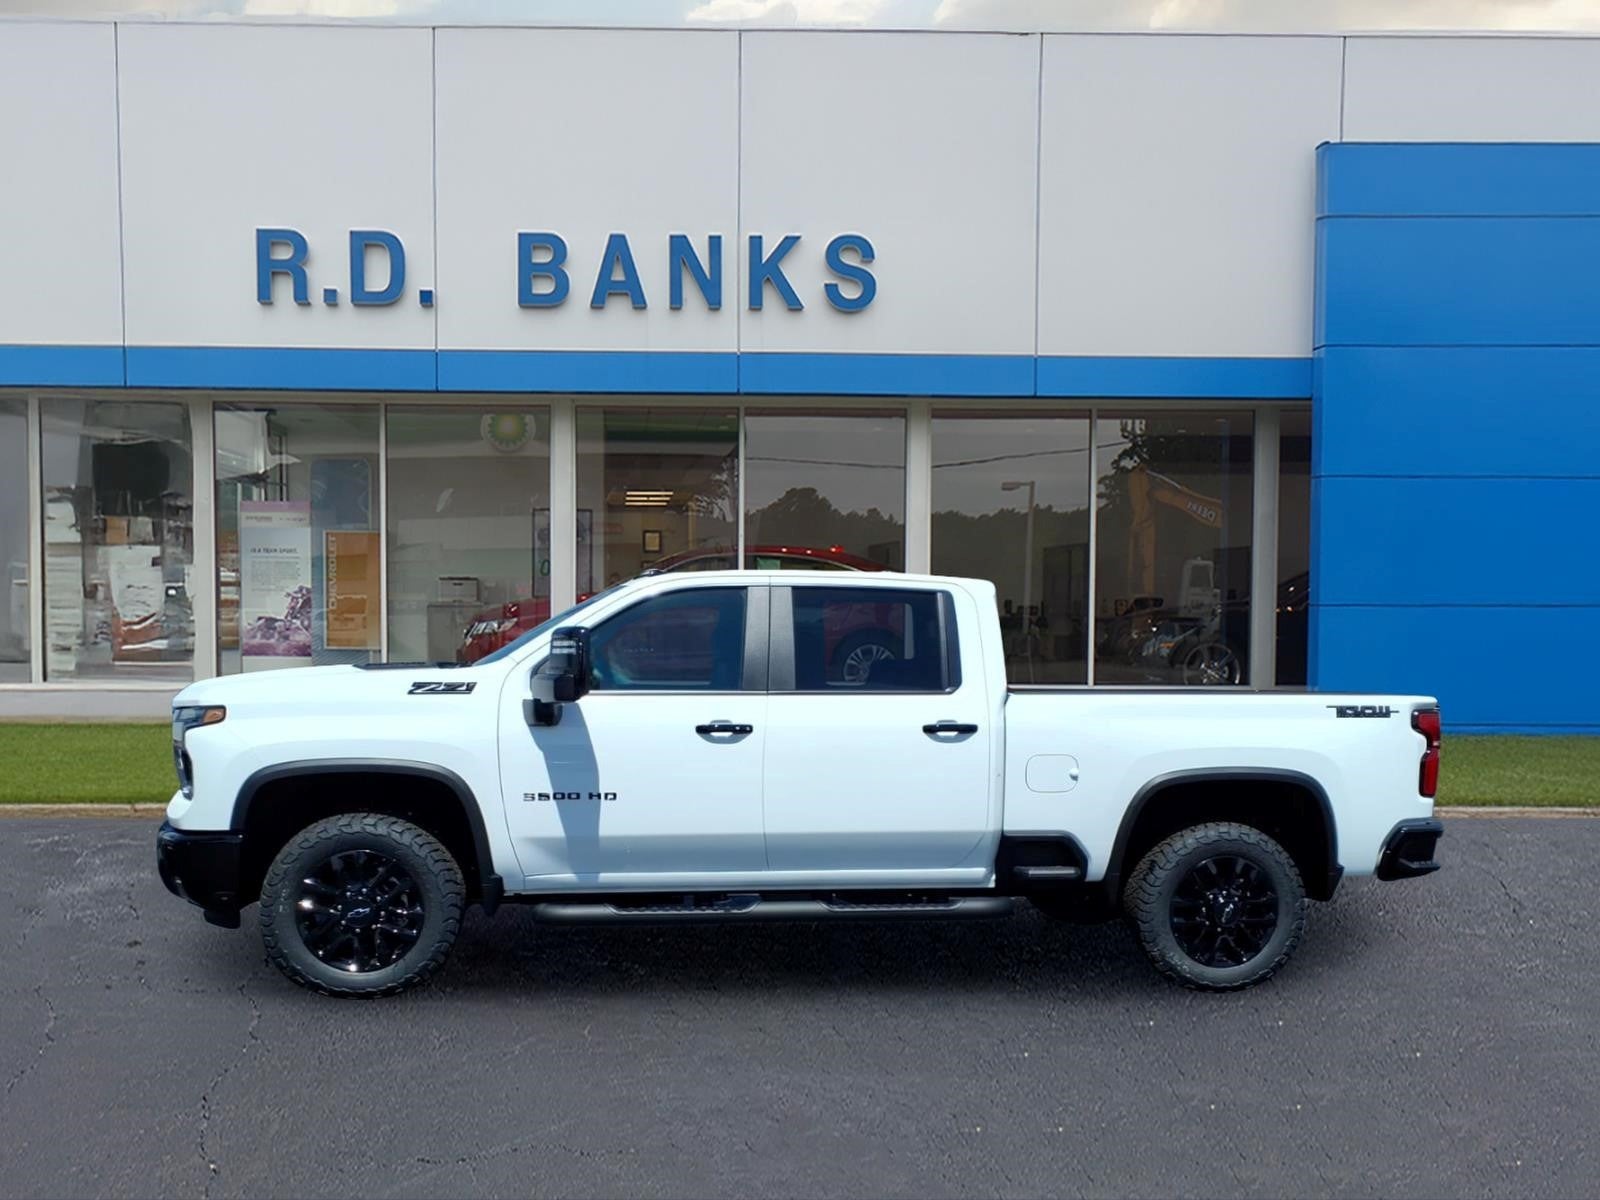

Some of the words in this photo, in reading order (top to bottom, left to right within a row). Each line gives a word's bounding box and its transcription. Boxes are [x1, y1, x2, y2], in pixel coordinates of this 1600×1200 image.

[255, 228, 434, 306] R.D.
[517, 232, 878, 312] BANKS
[588, 792, 617, 801] HD
